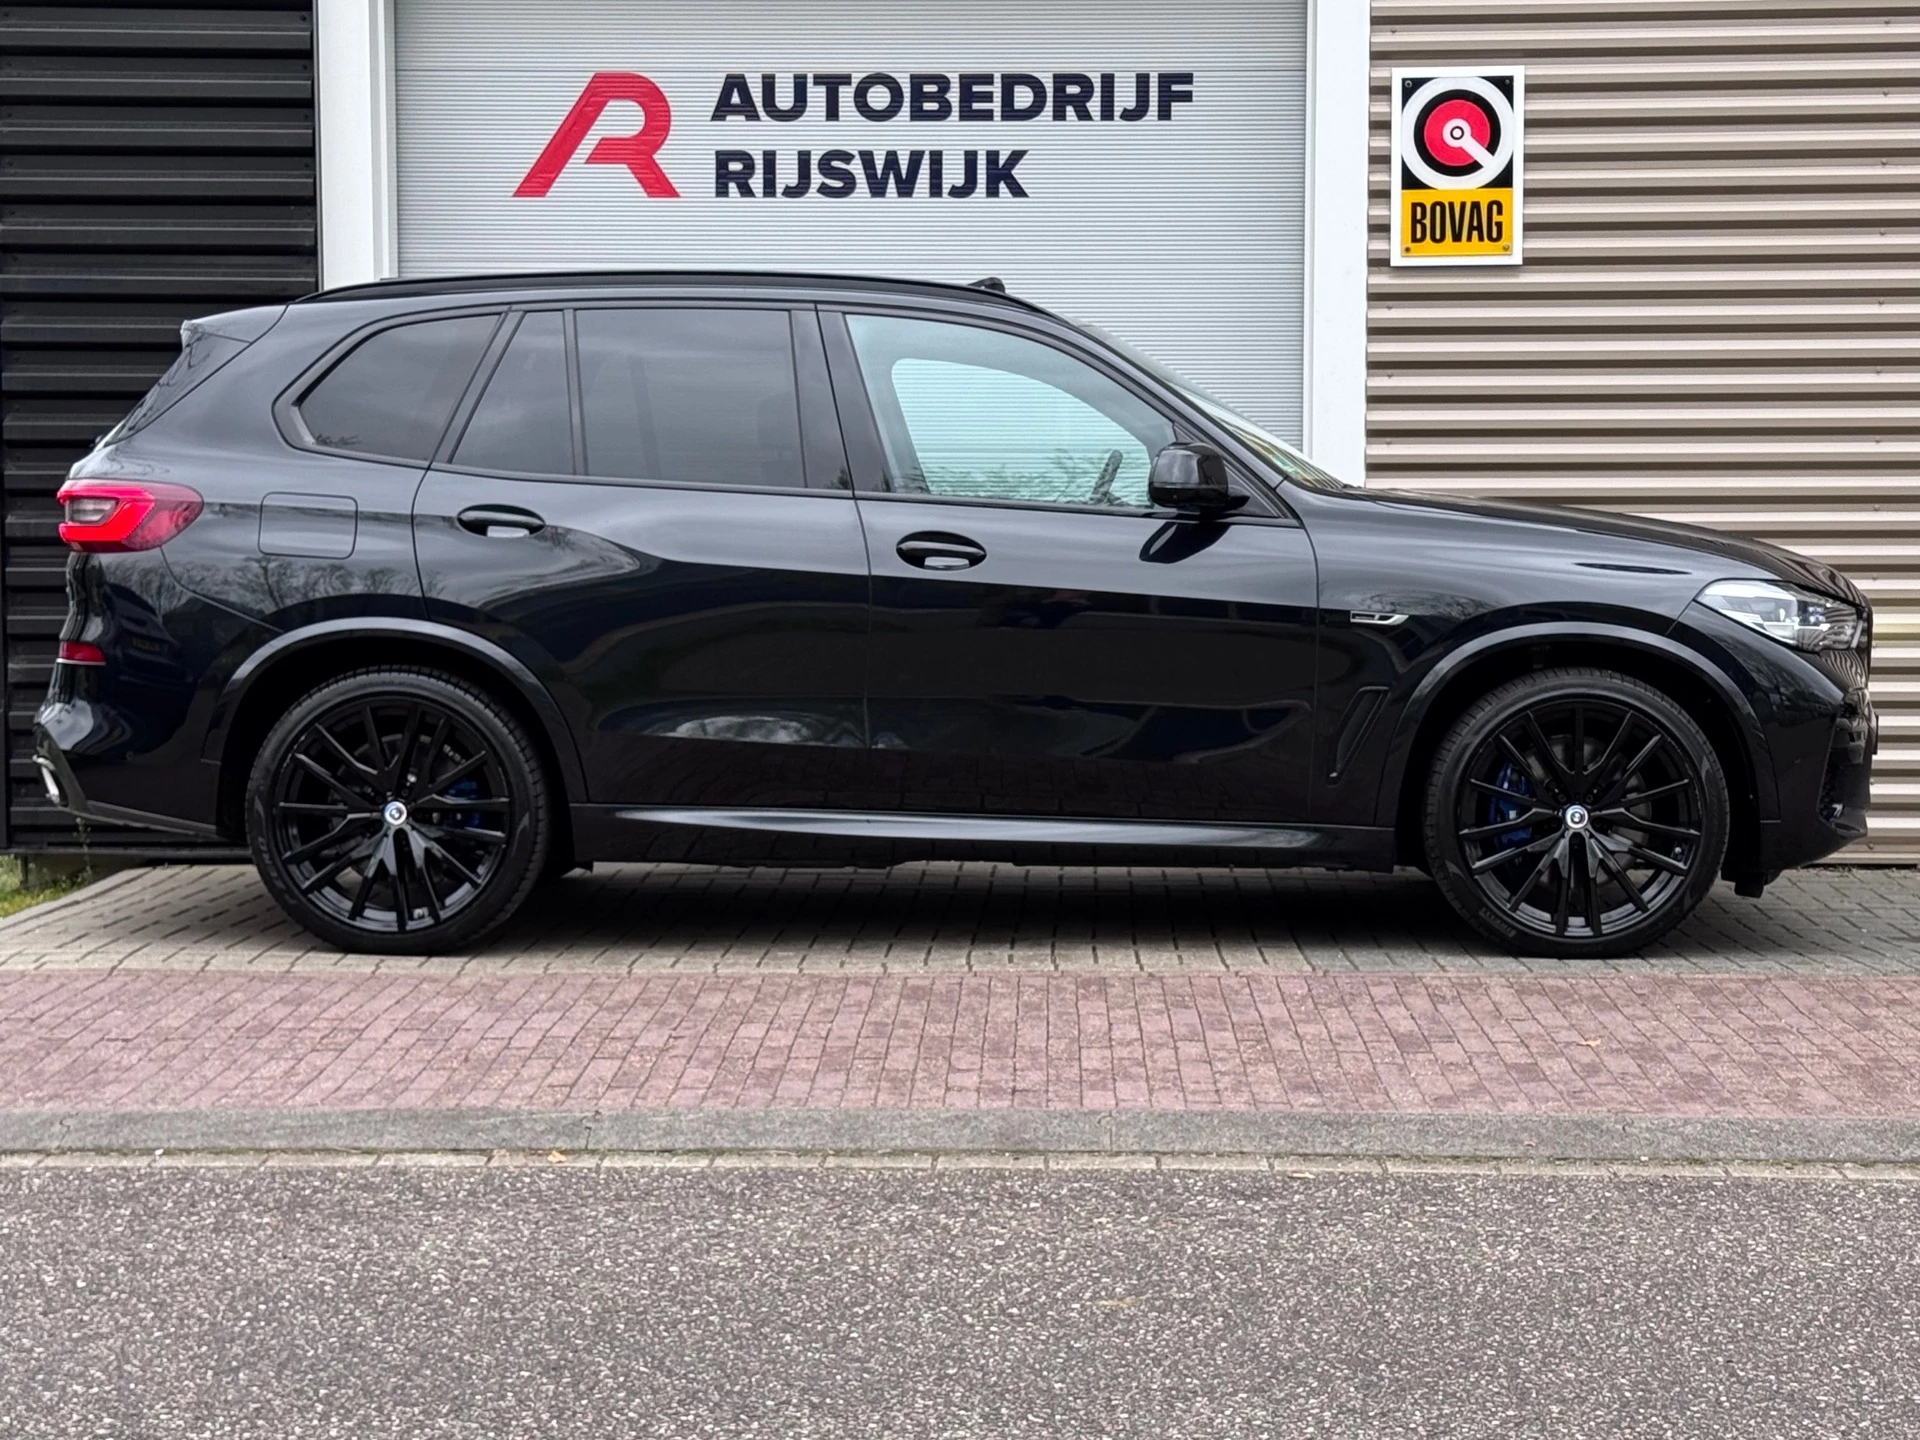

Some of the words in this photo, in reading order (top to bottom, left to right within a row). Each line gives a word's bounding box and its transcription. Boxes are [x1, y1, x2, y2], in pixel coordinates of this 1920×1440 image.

[710, 72, 1194, 122] AUTOBEDRIJF
[715, 149, 1030, 199] RIJSWIJK
[1410, 199, 1504, 244] BOVAG
